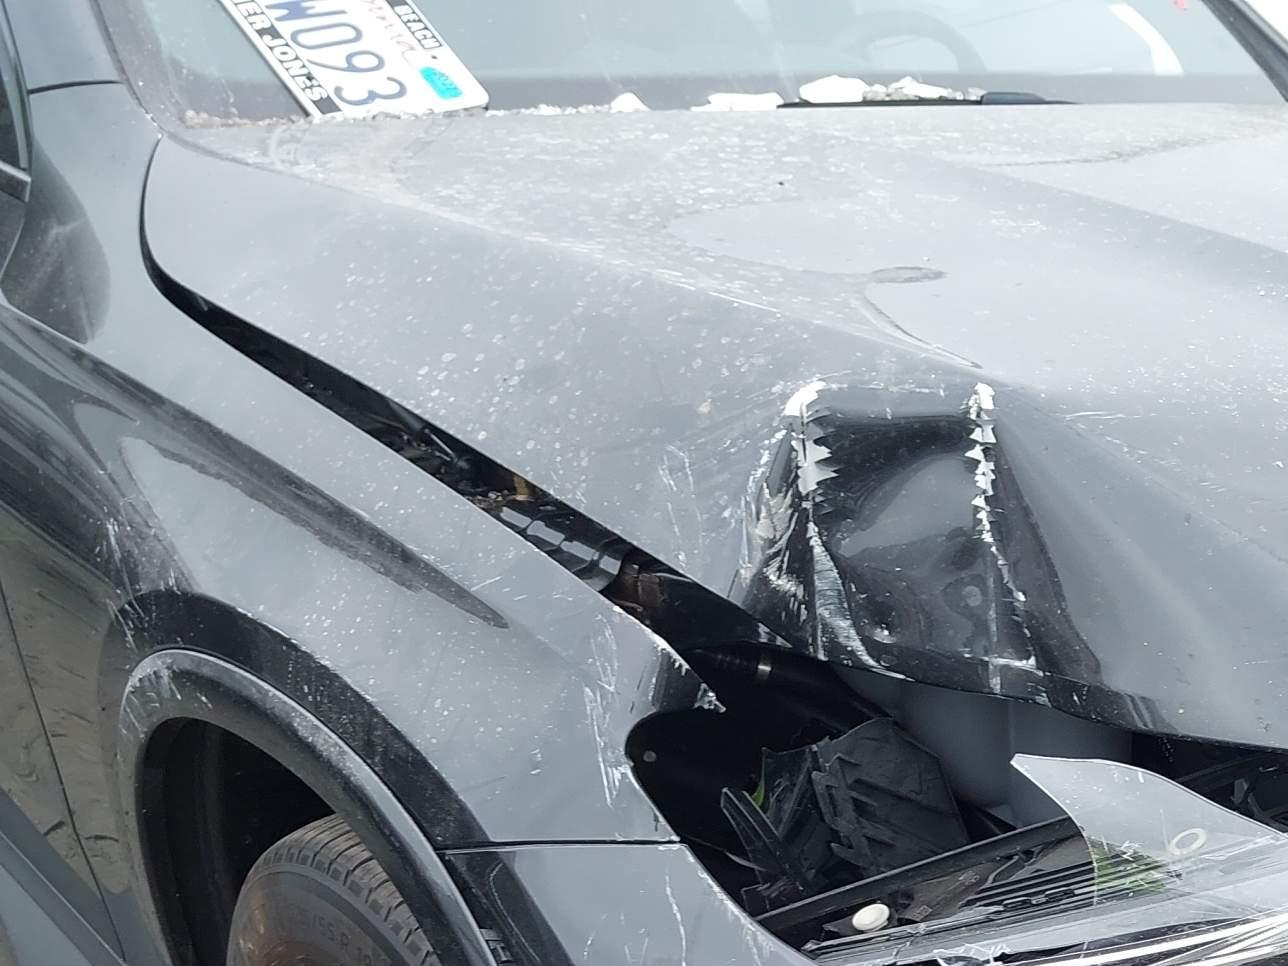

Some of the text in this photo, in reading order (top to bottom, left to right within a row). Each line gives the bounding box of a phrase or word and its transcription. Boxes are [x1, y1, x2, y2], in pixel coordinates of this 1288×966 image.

[231, 0, 328, 101] ER JONES
[394, 5, 442, 49] BEACH
